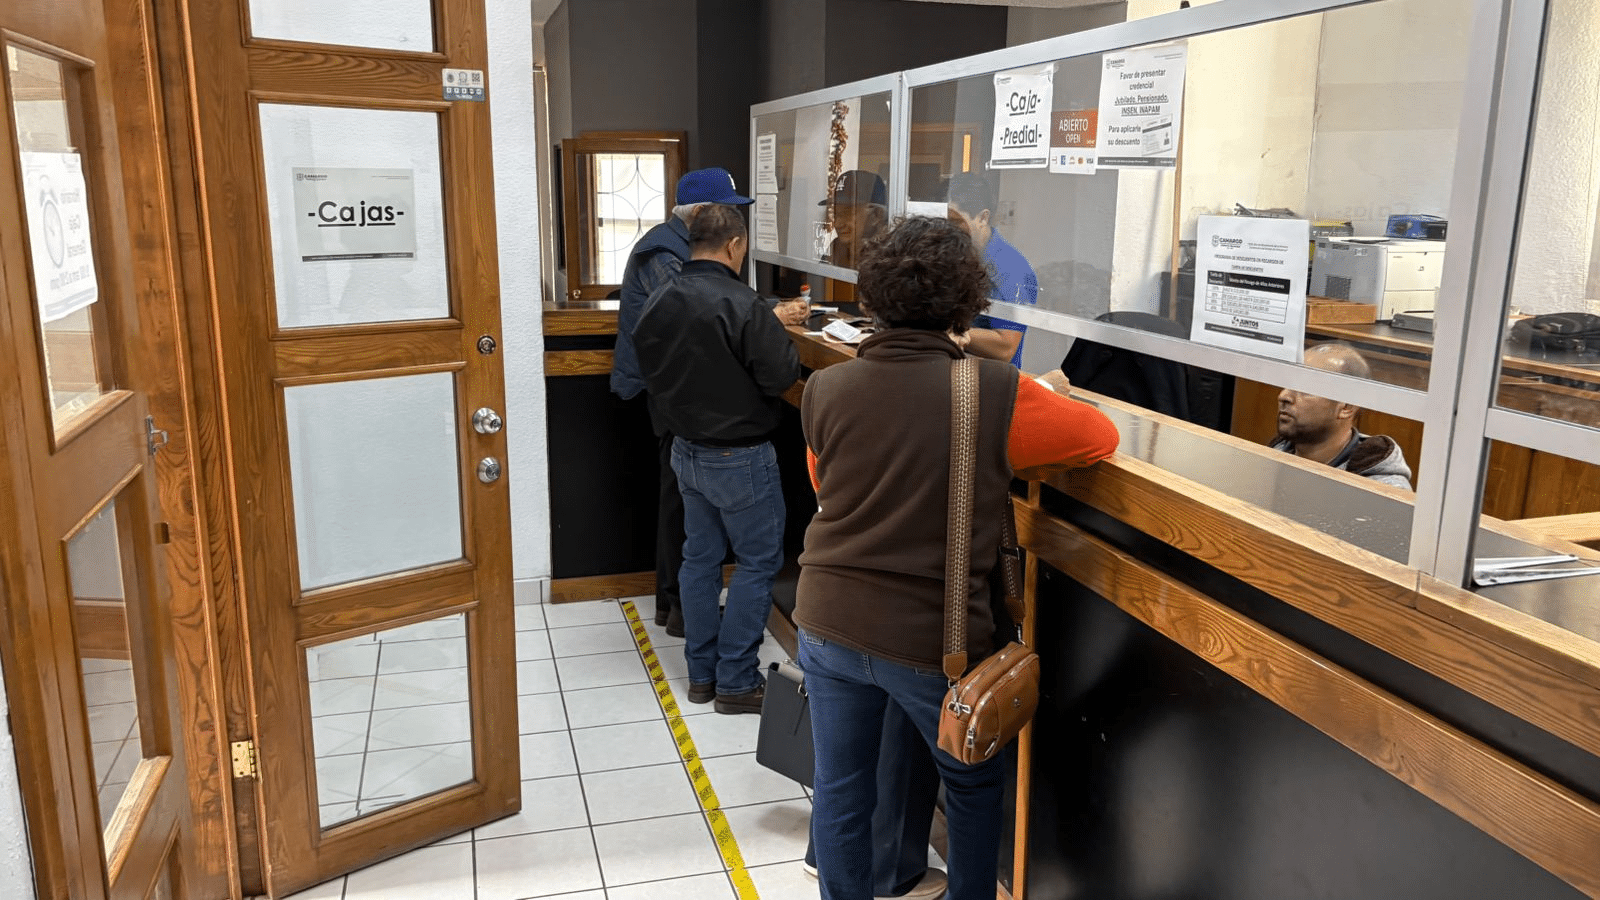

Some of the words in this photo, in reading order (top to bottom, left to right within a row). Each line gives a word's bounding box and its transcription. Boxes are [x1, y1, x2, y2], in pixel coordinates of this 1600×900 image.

[1120, 72, 1133, 80] Favor
[1141, 69, 1166, 79] presentar
[1129, 81, 1154, 90] credencial
[1059, 118, 1089, 132] ABIERTO
[1065, 133, 1081, 144] OPEN
[1115, 138, 1141, 146] descuento
[1219, 237, 1243, 245] CAMARGO
[1239, 319, 1259, 328] JUNTOS
